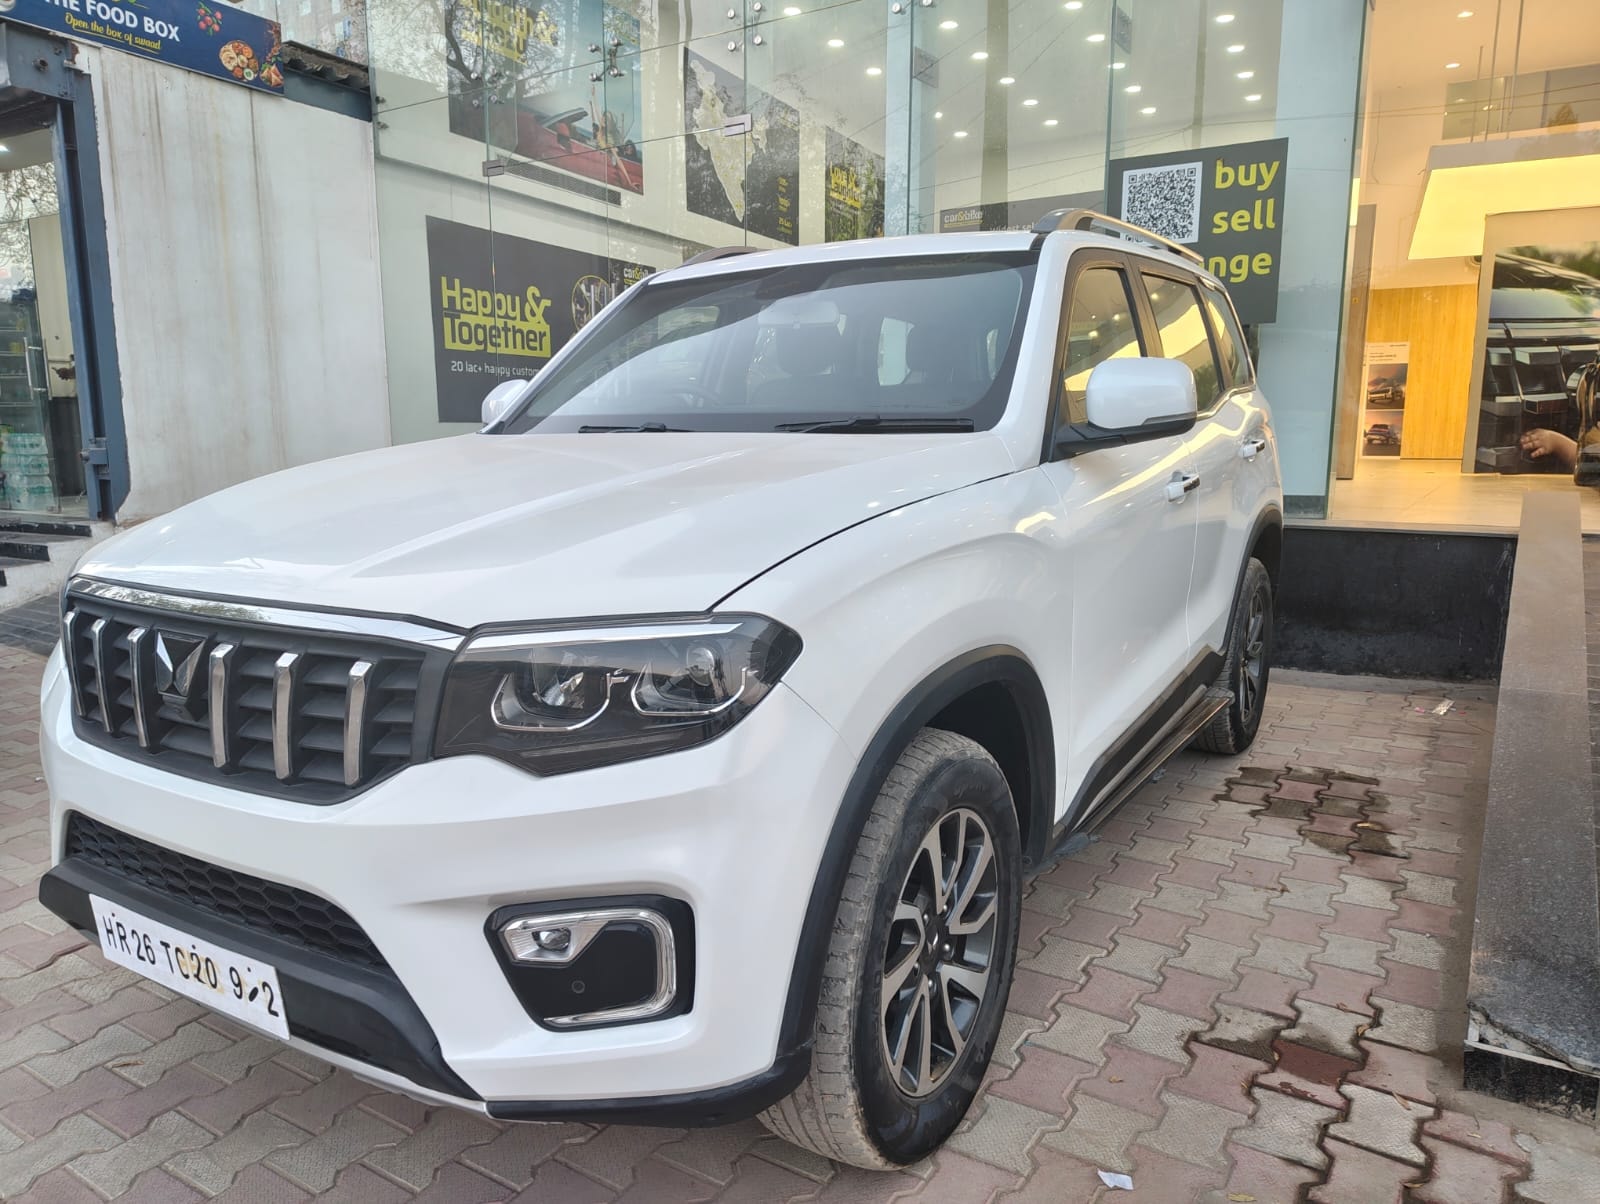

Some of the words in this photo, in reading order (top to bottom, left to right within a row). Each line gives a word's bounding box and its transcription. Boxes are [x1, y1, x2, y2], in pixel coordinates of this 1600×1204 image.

[65, 12, 89, 30] Open
[90, 20, 104, 33] the
[106, 24, 122, 40] box
[124, 33, 133, 46] of
[86, 0, 138, 28] FOOD
[143, 16, 180, 42] BOX
[1215, 158, 1281, 192] buy
[1211, 198, 1275, 234] sell
[441, 275, 521, 320] Happy
[524, 286, 551, 325] &
[444, 312, 547, 352] Together
[451, 361, 464, 372] 20
[465, 361, 482, 373] lac+
[484, 363, 511, 377] happy
[103, 915, 156, 966] HR26
[160, 940, 218, 990] TC20
